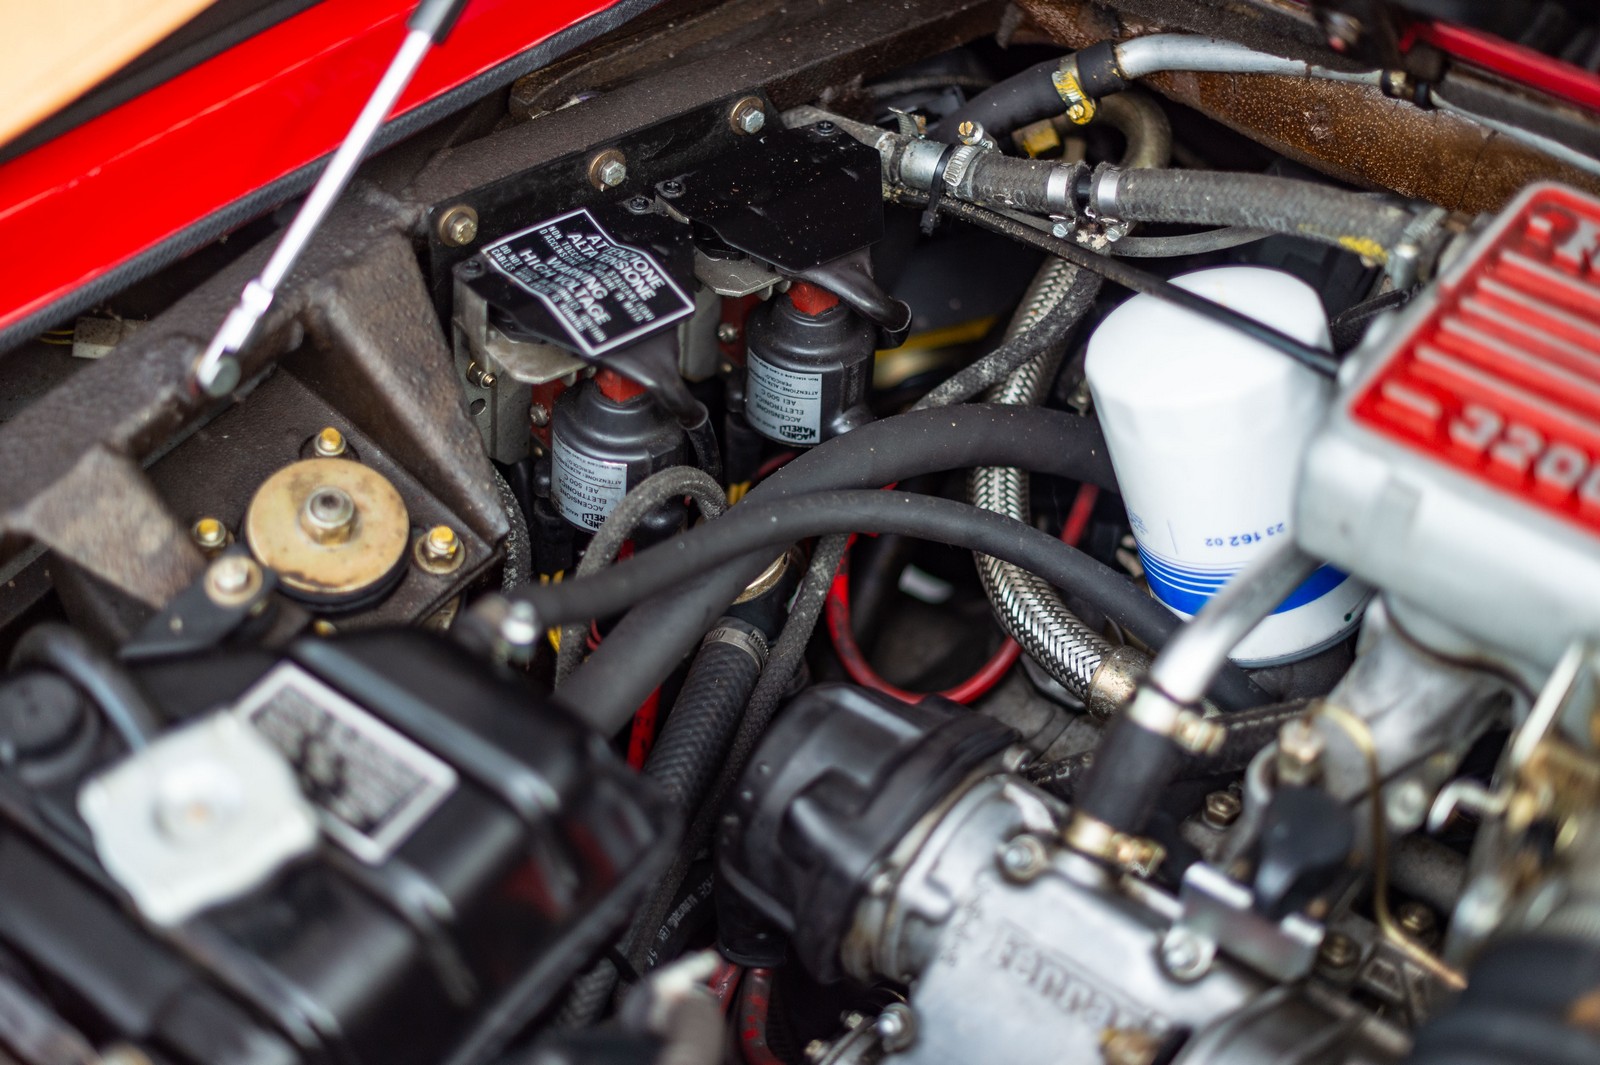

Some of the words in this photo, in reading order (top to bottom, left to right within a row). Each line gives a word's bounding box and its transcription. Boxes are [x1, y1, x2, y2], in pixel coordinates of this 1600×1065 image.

[491, 249, 515, 272] CABLES
[508, 254, 522, 266] NOT
[567, 233, 598, 259] ALTA
[594, 252, 656, 301] TENSIONE
[586, 234, 666, 290] ATTENZIONE
[519, 248, 555, 278] HIGH
[552, 275, 611, 325] VOLTAGE
[546, 256, 609, 300] WARNING
[754, 393, 804, 414] ELETTRONICA
[766, 392, 780, 400] 500
[756, 403, 801, 422] ACCENSIONE
[558, 477, 607, 504] ELETTRONICA
[570, 477, 582, 488] 500
[586, 485, 599, 493] AEI
[559, 487, 604, 511] ACCENSIONE
[1229, 531, 1261, 547] 162
[1266, 523, 1285, 536] 23
[1204, 537, 1223, 547] 02
